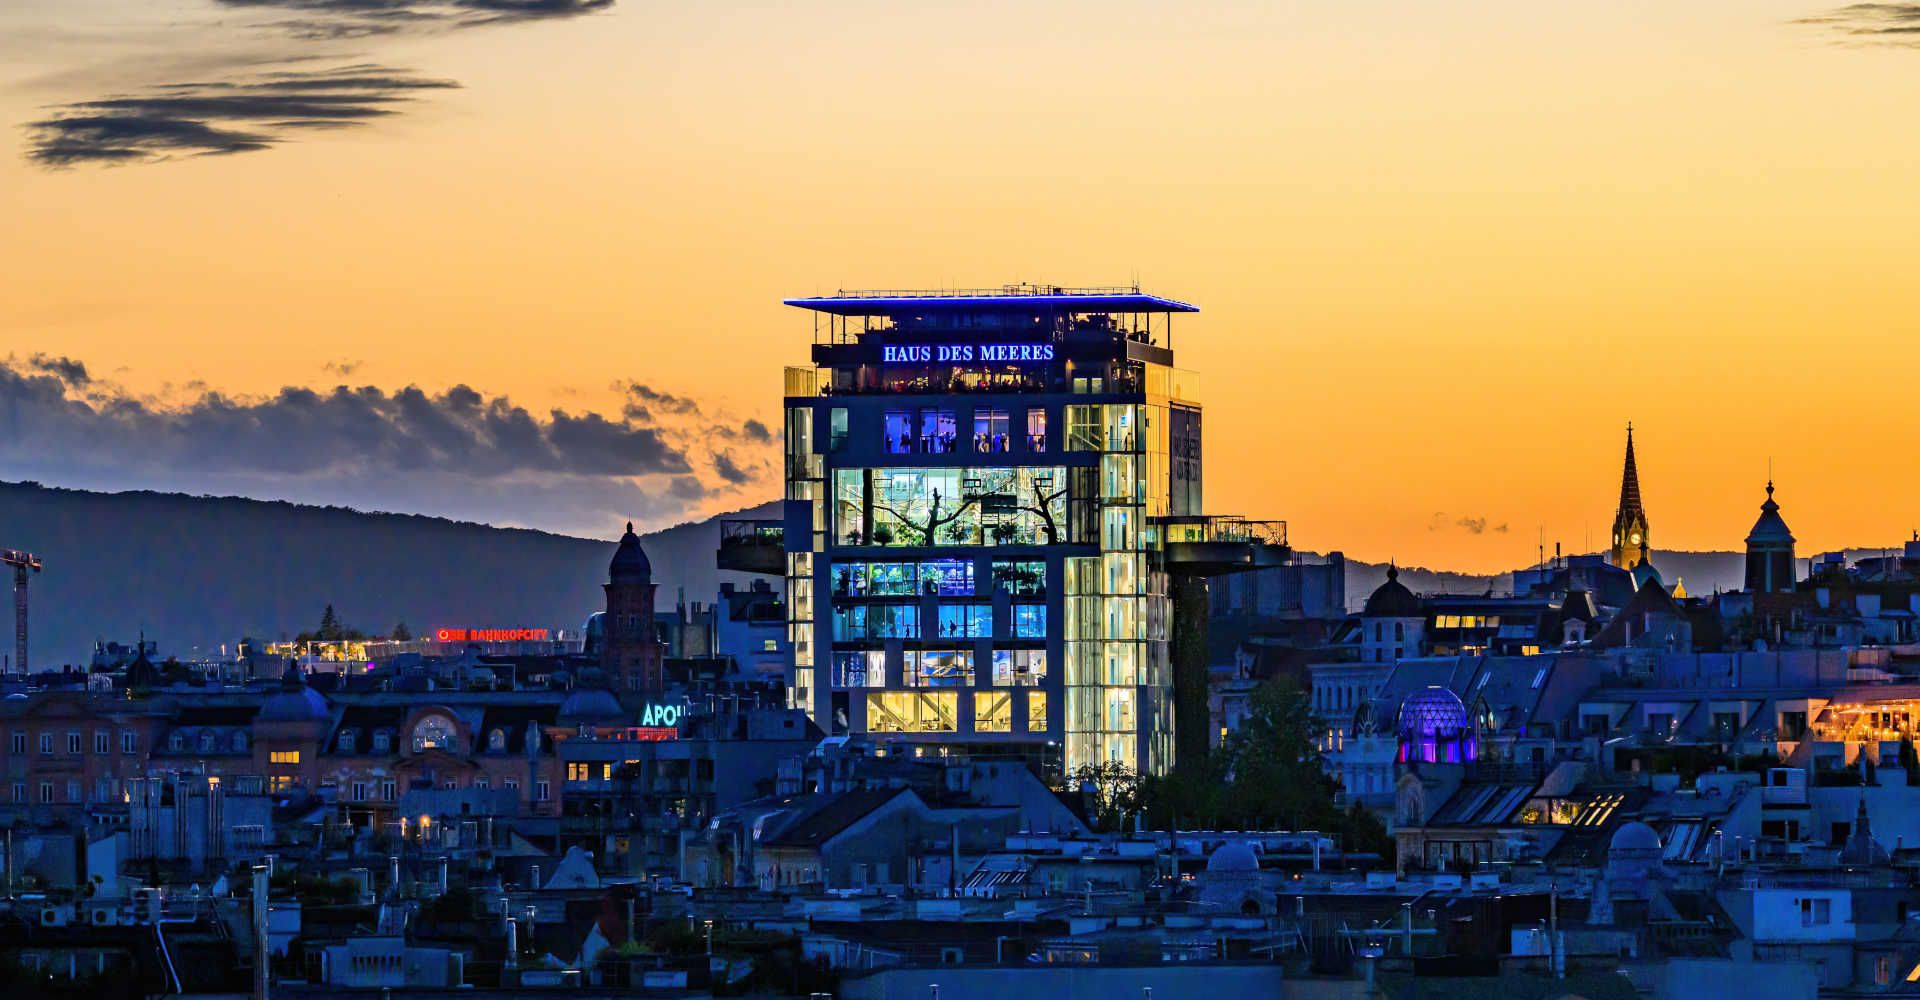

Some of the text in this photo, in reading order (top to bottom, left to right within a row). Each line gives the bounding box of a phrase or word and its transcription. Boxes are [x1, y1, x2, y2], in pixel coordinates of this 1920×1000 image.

[884, 345, 1054, 362] HAUS DES MEERES
